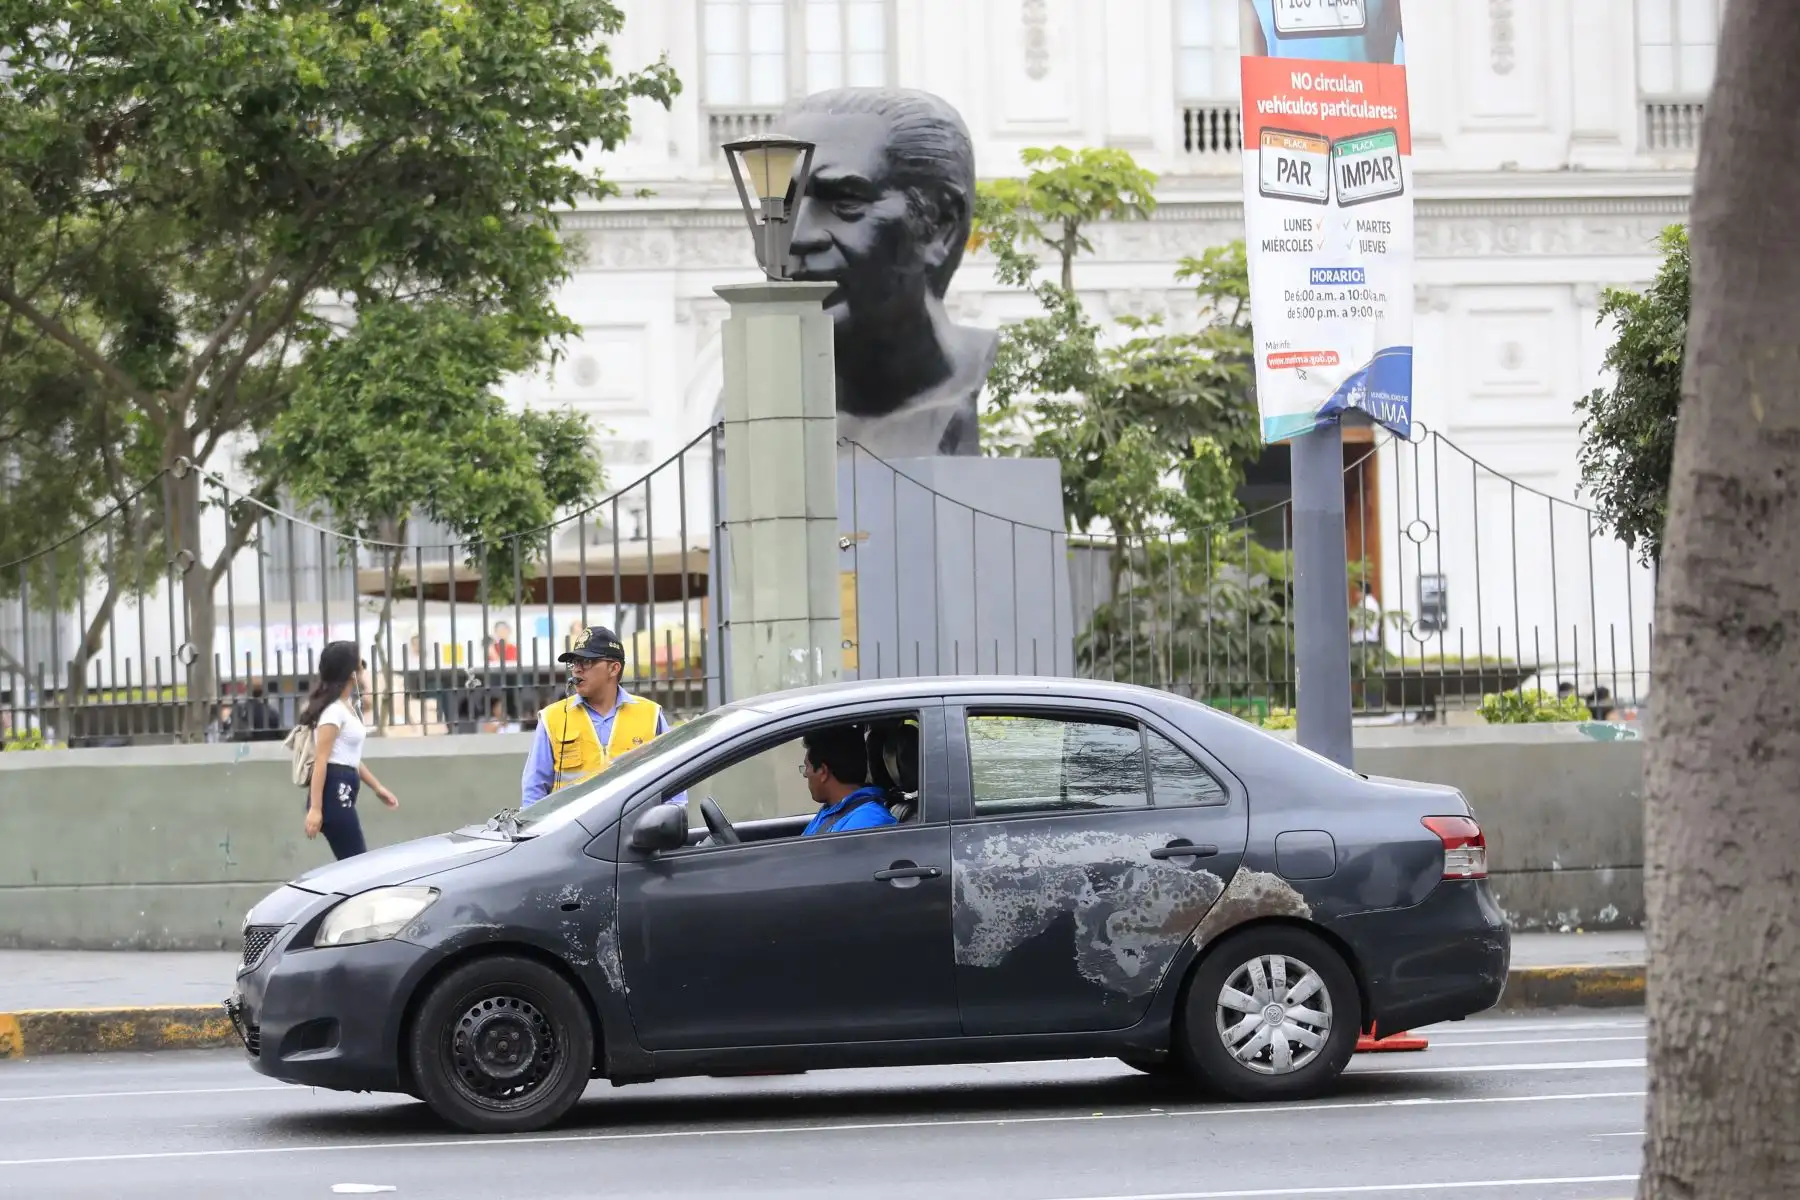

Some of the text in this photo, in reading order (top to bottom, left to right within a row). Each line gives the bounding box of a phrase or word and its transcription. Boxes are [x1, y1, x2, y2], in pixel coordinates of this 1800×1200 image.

[1290, 71, 1364, 93] NO circulan
[1257, 95, 1398, 120] vehículos particulares:
[1283, 138, 1308, 150] PLACA
[1351, 140, 1375, 153] PLACA
[1277, 157, 1312, 187] PAR
[1341, 156, 1396, 189] IMPAR
[1283, 218, 1313, 232] LUNES
[1356, 220, 1392, 234] MARTES
[1359, 239, 1387, 254] JUEVES
[1311, 269, 1364, 283] HORARIO:
[1284, 290, 1295, 302] De
[1295, 290, 1315, 302] 6:00
[1316, 292, 1337, 301] a.m.
[1339, 292, 1346, 301] a
[1287, 308, 1296, 319] de
[1296, 307, 1315, 319] 5:00
[1317, 308, 1340, 322] p.m.
[1342, 309, 1348, 318] a
[1350, 306, 1373, 318] 9:00
